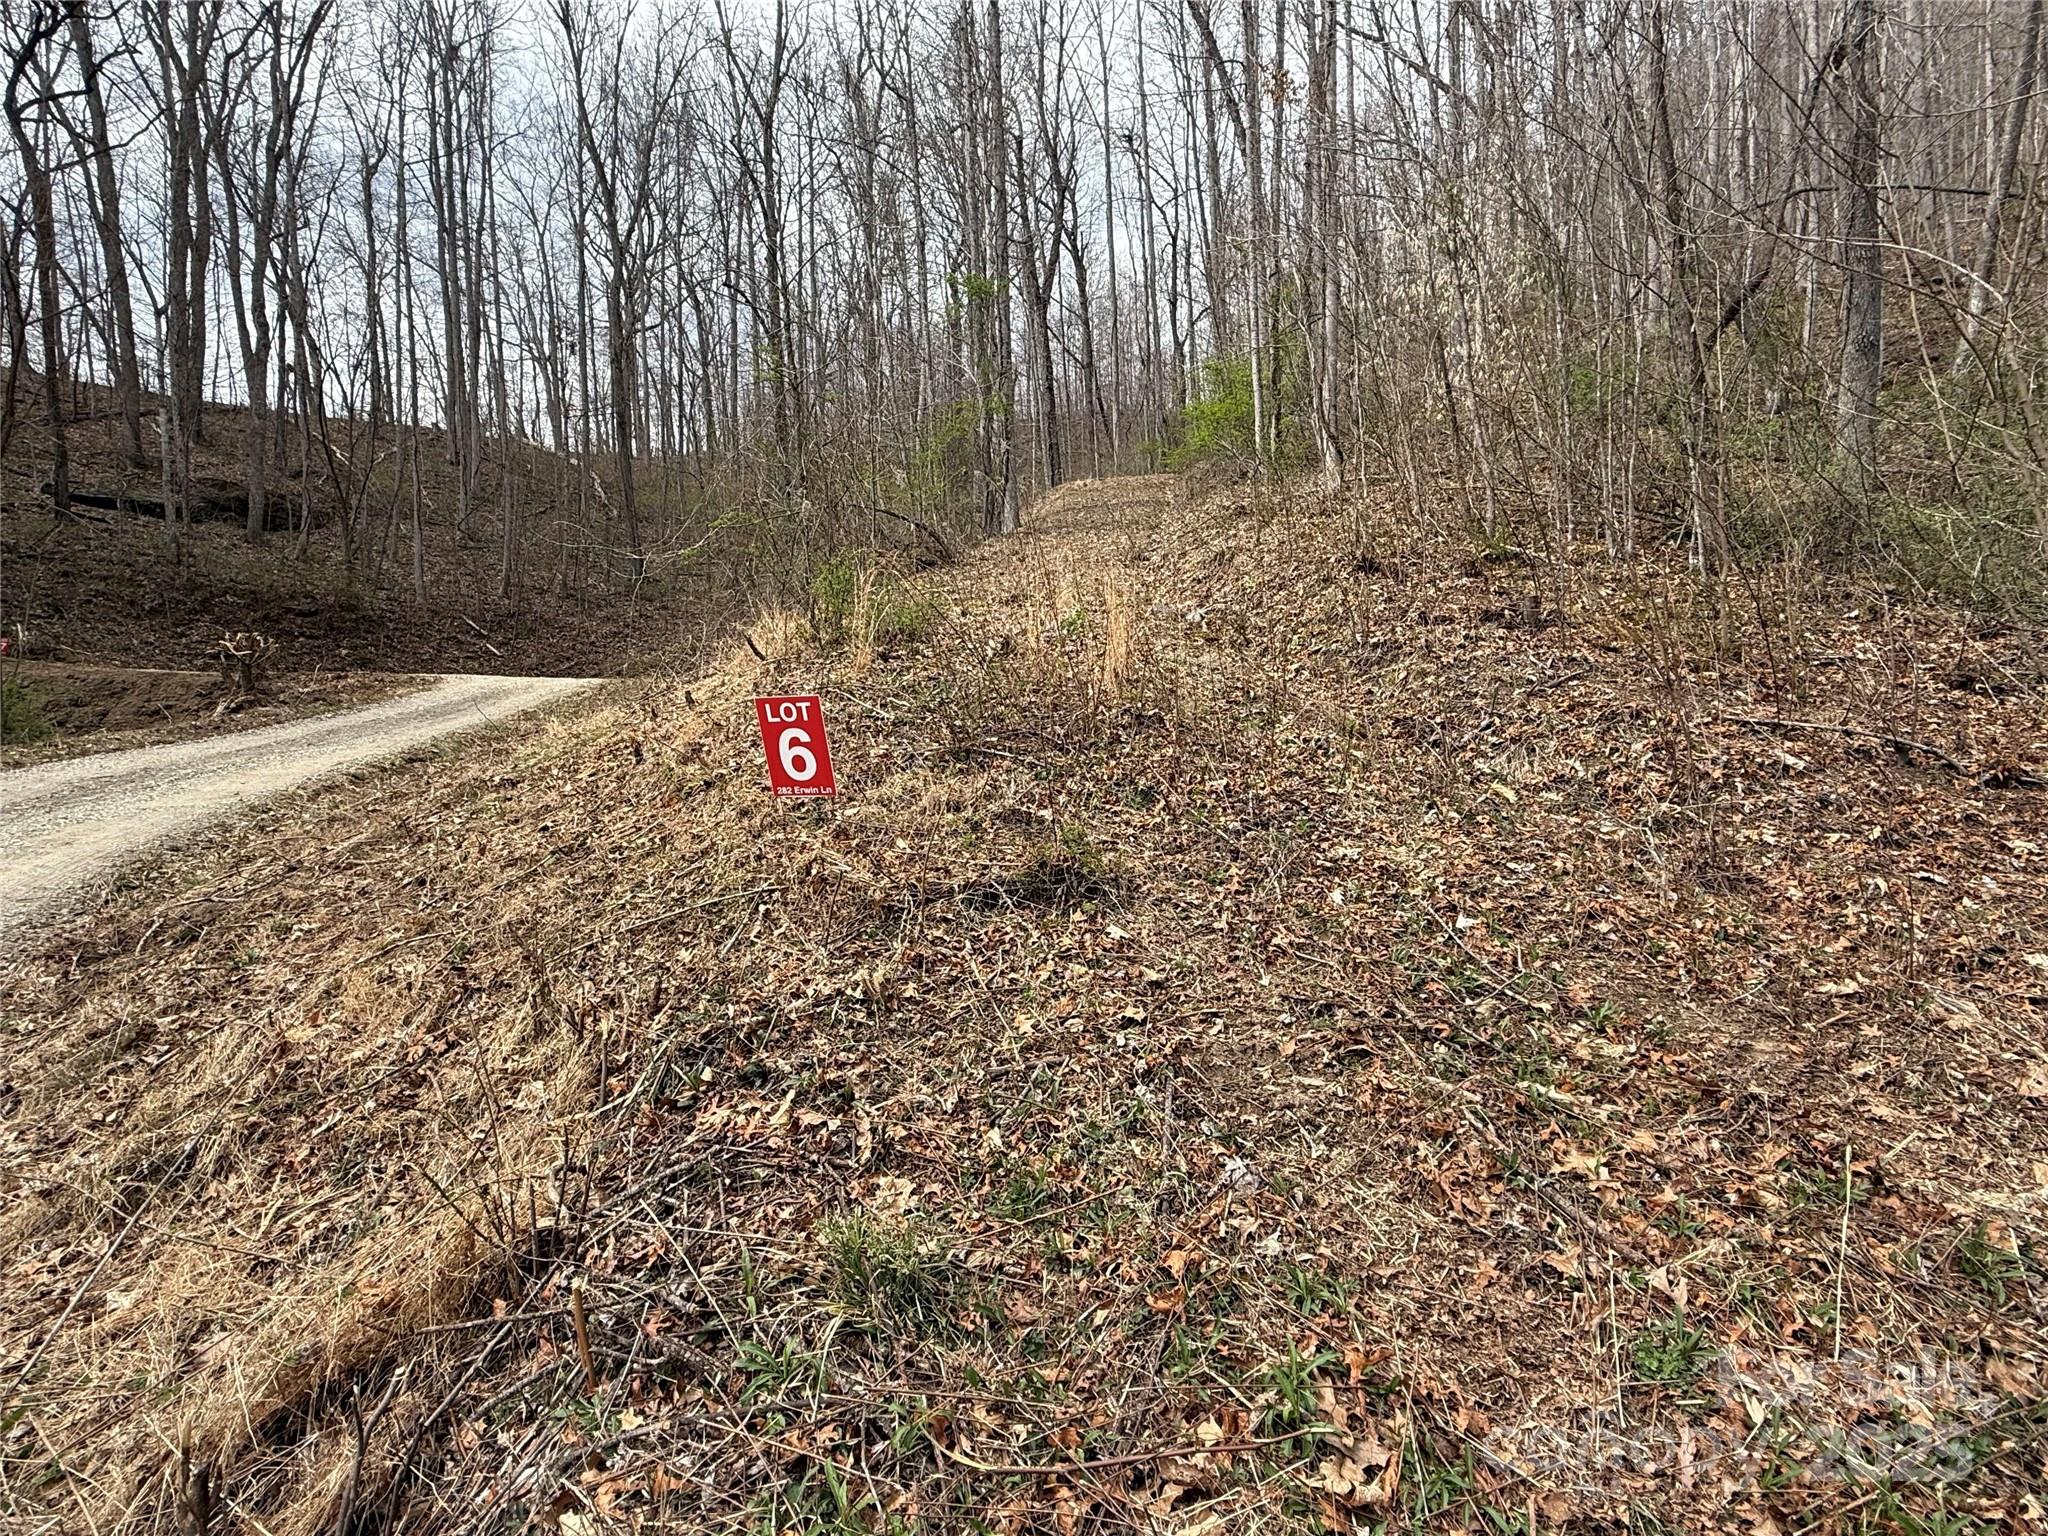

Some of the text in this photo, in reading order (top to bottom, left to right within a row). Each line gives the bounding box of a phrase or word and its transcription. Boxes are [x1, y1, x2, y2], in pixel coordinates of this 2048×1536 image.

[764, 702, 811, 722] LOT
[778, 727, 817, 781] 6
[776, 785, 833, 794] 282 Erwin Ln
